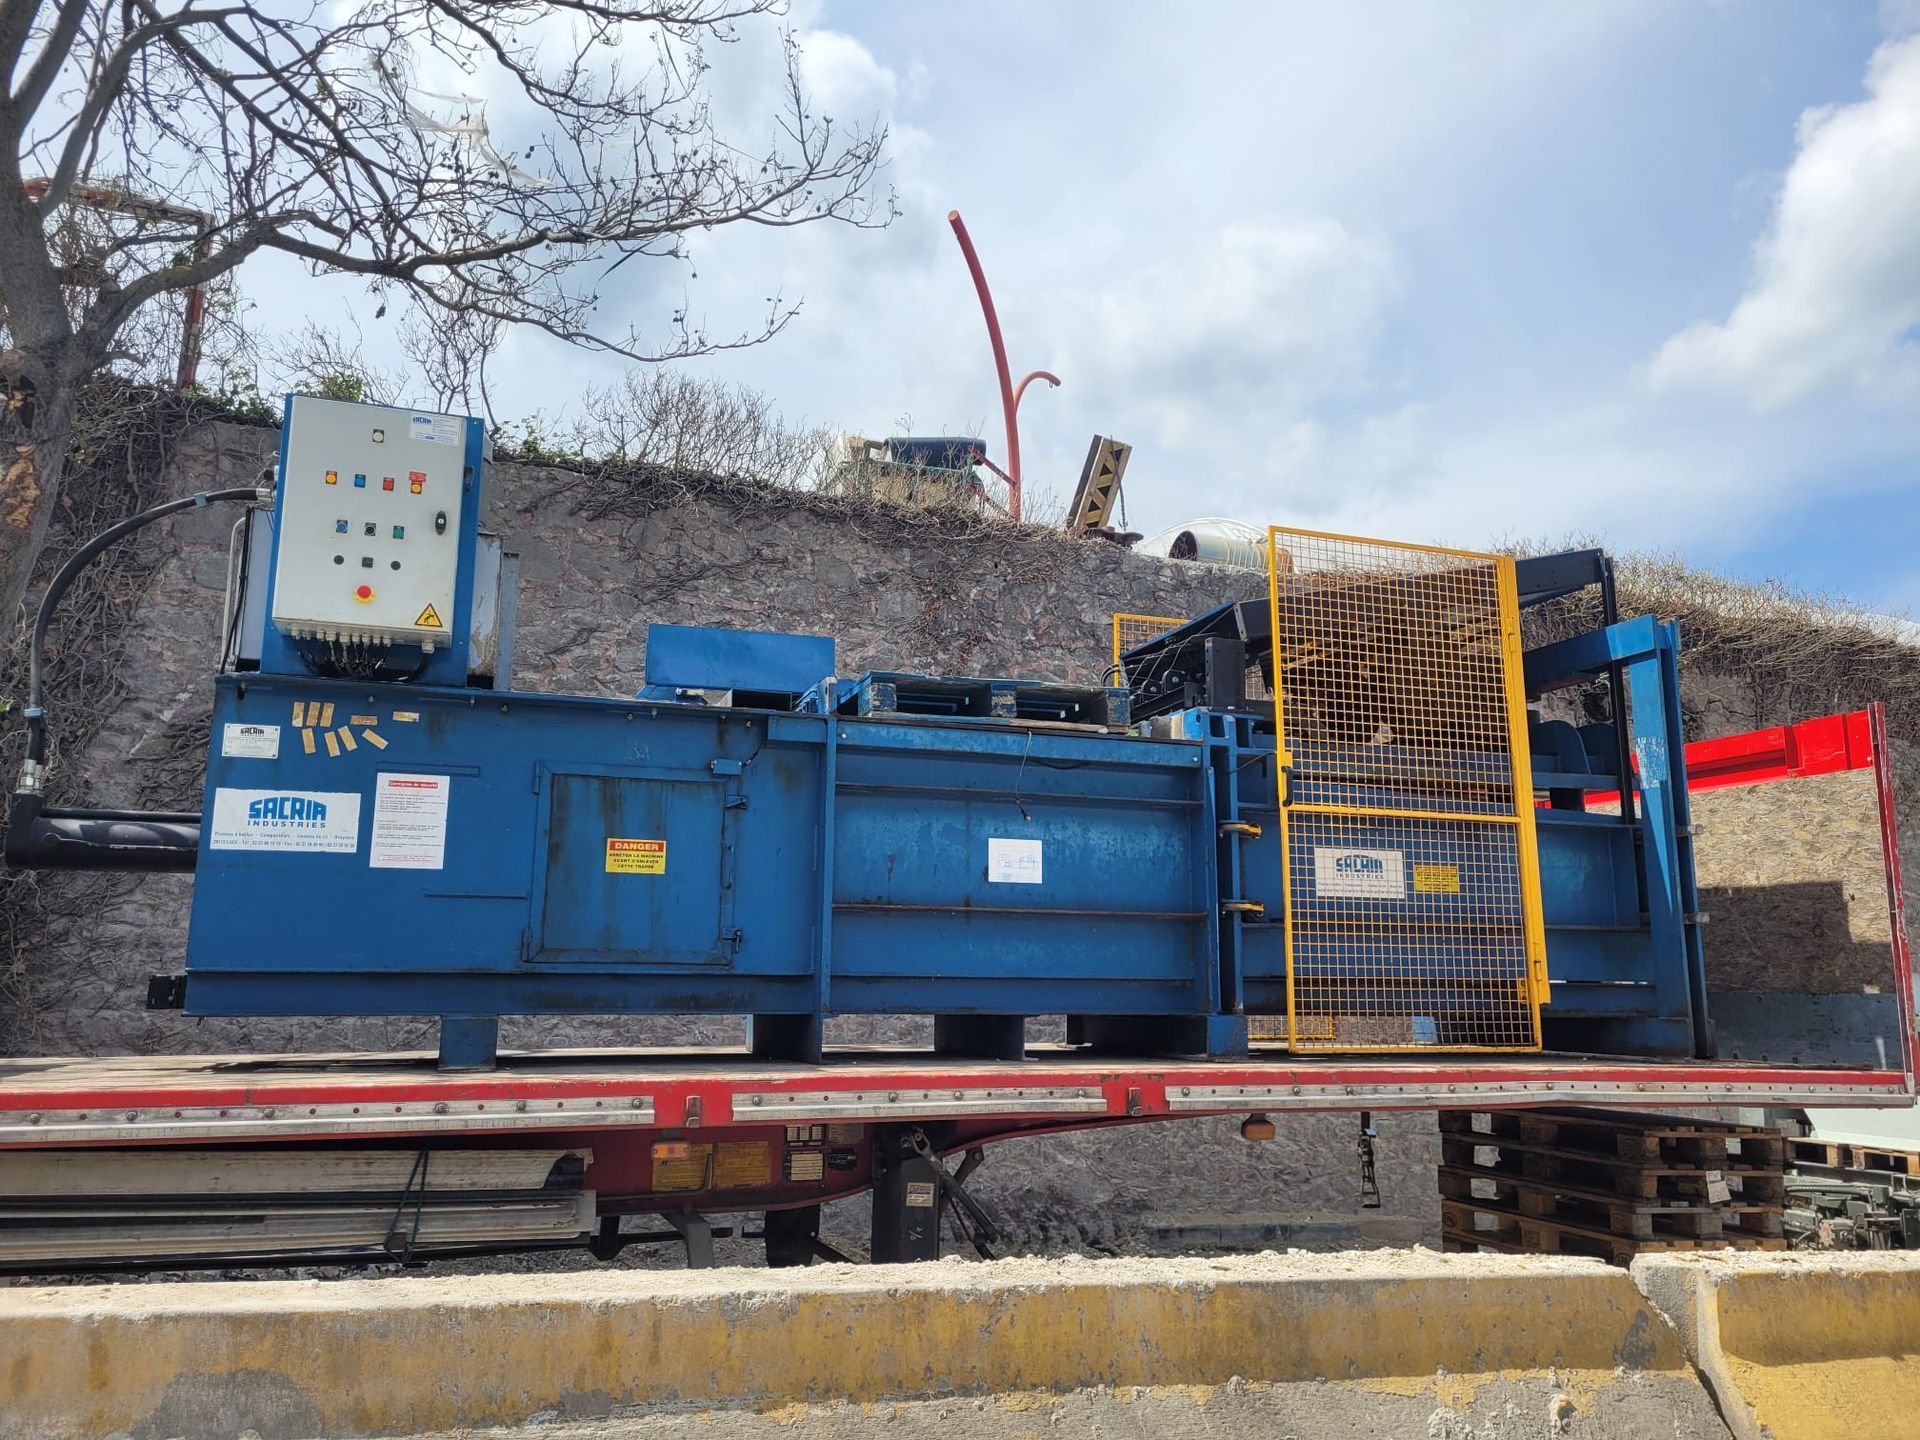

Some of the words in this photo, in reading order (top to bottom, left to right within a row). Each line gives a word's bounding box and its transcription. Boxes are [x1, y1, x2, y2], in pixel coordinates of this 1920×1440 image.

[248, 796, 327, 821] SACRIA
[247, 820, 326, 828] INDUSTRIES
[614, 842, 659, 851] DANGER
